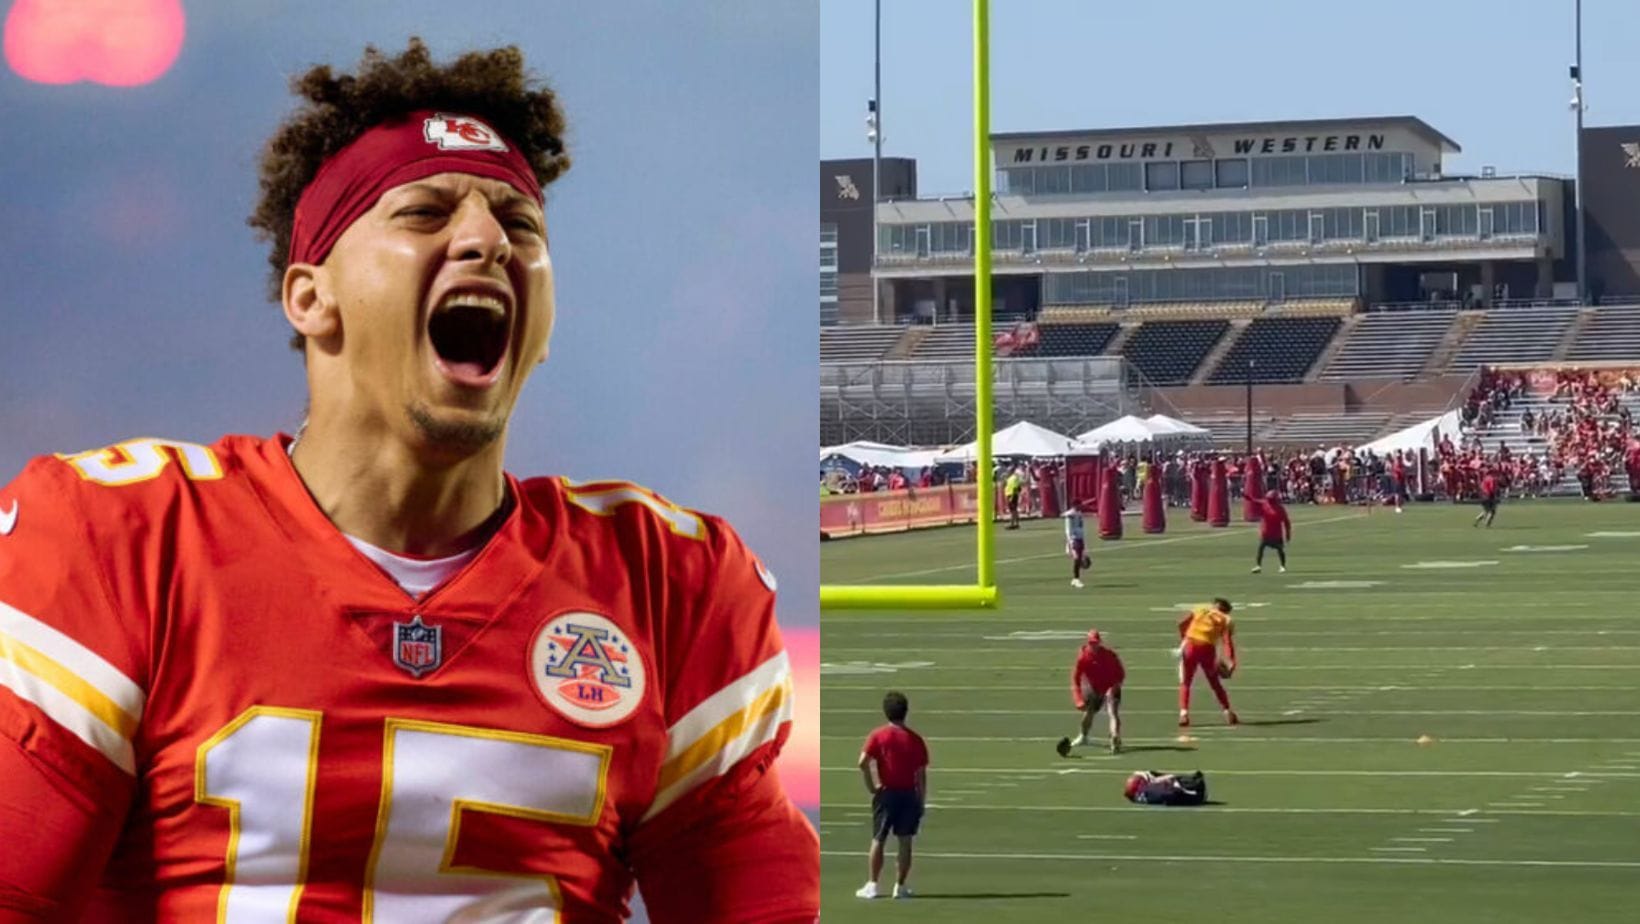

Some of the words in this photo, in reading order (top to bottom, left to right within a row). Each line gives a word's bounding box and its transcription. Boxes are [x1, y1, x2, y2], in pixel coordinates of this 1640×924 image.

[445, 119, 491, 144] KC
[1014, 142, 1173, 163] MISSOURI
[1234, 134, 1384, 154] WESTERN
[401, 641, 435, 667] NFL
[195, 705, 613, 924] 15
